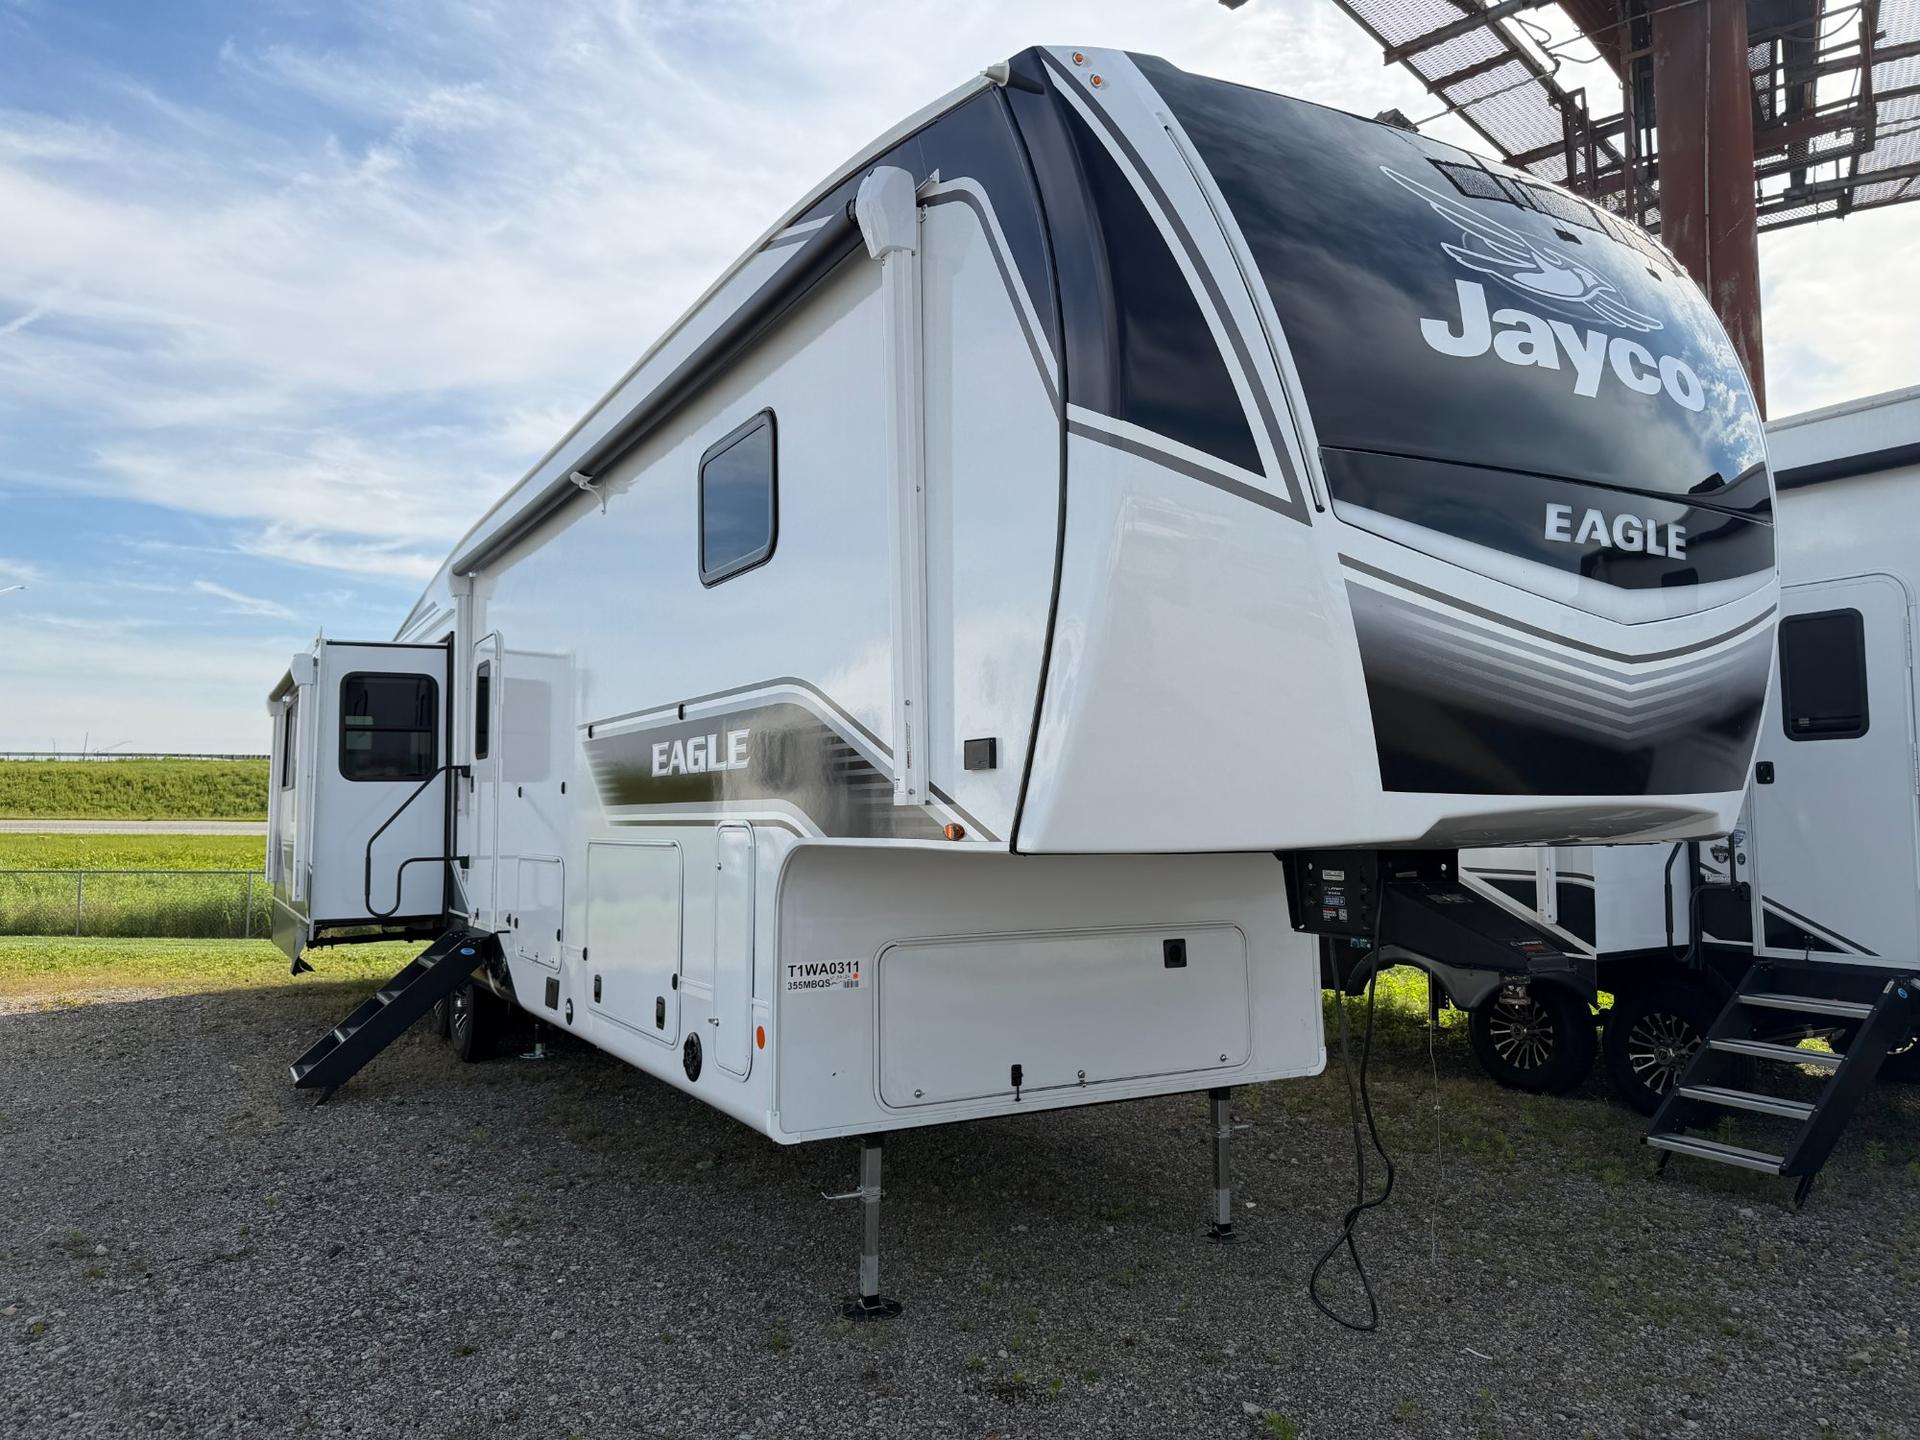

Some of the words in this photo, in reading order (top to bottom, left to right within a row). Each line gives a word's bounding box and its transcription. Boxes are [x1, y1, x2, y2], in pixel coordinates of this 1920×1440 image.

[1420, 279, 1706, 412] Jayco
[1544, 502, 1687, 561] EAGLE
[651, 728, 751, 778] EAGLE
[787, 979, 831, 991] 355MBQS
[788, 960, 859, 978] T1WA0311
